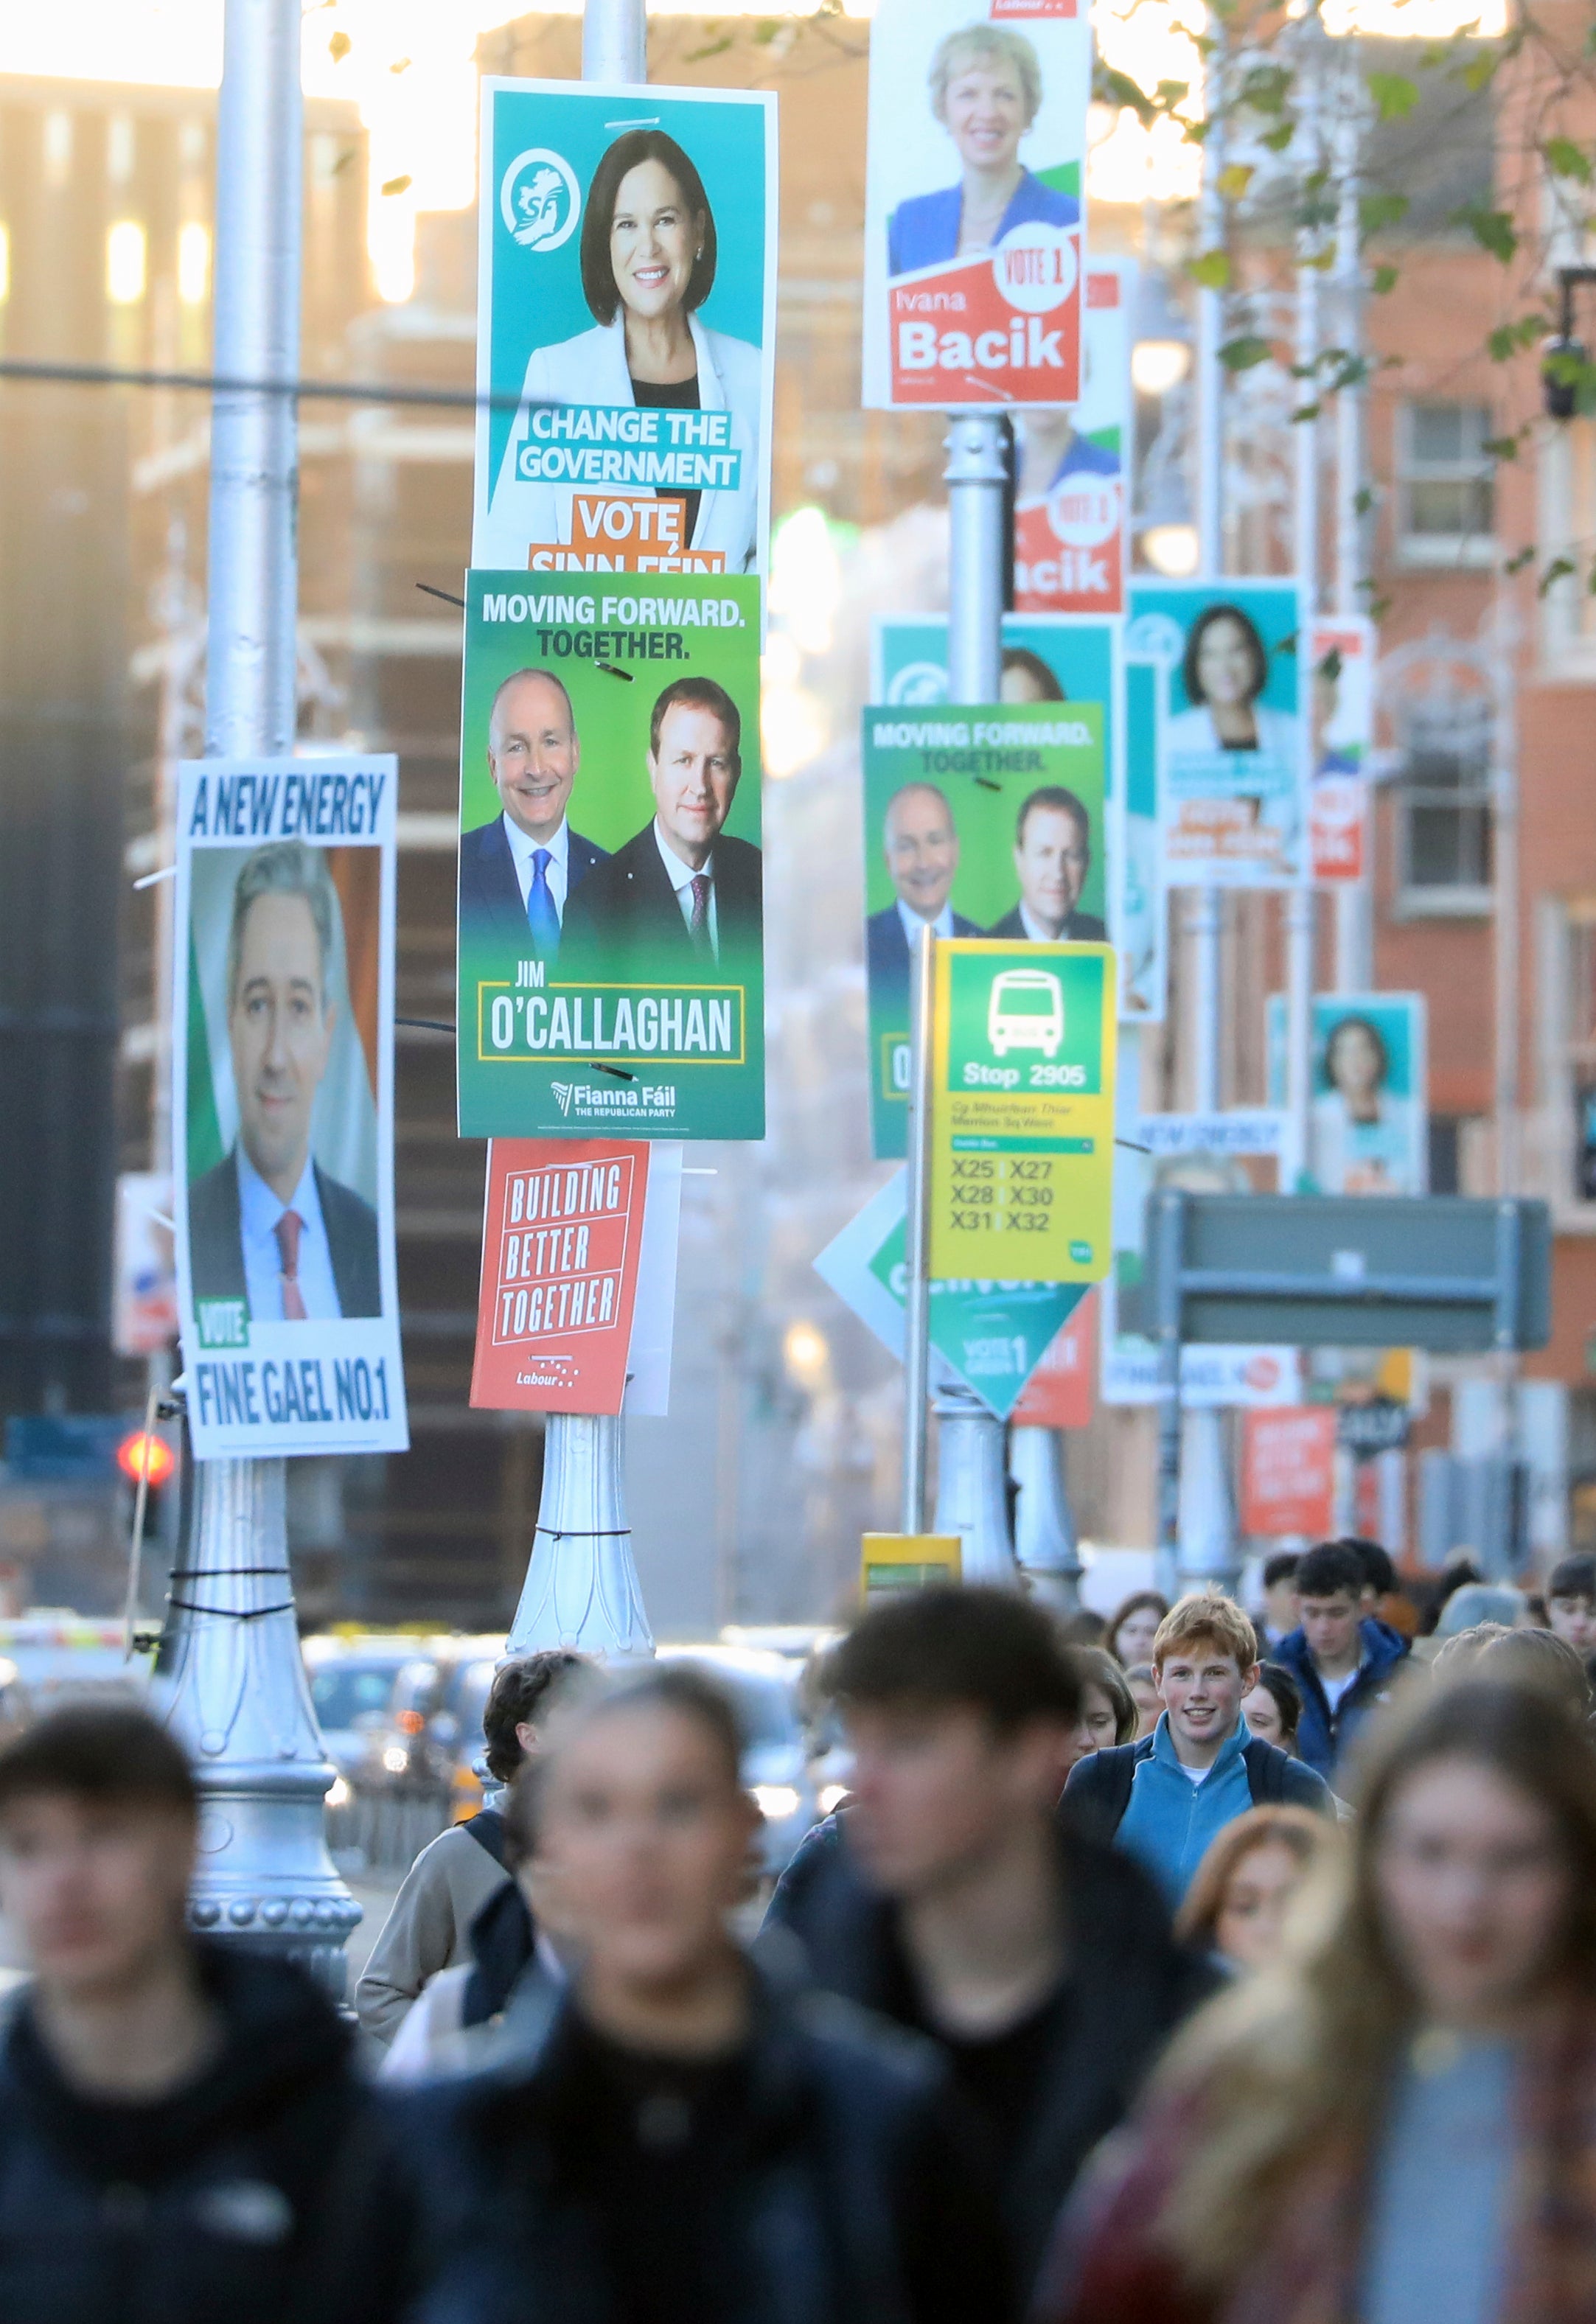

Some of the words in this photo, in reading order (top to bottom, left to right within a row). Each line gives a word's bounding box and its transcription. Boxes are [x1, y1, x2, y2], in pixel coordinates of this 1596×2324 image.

[526, 195, 559, 220] SF
[1005, 248, 1045, 285] VOTE
[1053, 247, 1064, 285] 1
[896, 290, 966, 312] Ivana
[898, 316, 1065, 370] Bacik
[531, 409, 658, 442] CHANGE
[666, 413, 728, 445] THE
[518, 445, 736, 486] GOVERNMENT
[577, 500, 680, 542] VOTE
[483, 594, 596, 625] MOVING
[601, 596, 745, 627] FORWARD.
[536, 629, 690, 660] TOGETHER.
[873, 723, 969, 748] MOVING
[973, 722, 1093, 747] FORWARD.
[921, 750, 1047, 773] TOGETHER.
[189, 775, 209, 836] A
[214, 774, 282, 836] NEW
[279, 772, 386, 836] ENERGY
[515, 960, 544, 988] JIM
[491, 995, 731, 1052] O'CALLAGHAN
[962, 1061, 1020, 1089] Stop
[1029, 1064, 1087, 1087] 2905
[574, 1085, 638, 1106] Fianna
[642, 1086, 676, 1106] Fáil
[575, 1108, 592, 1116] THE
[593, 1108, 647, 1117] REPUBLICAN
[648, 1109, 676, 1117] PARTY
[949, 1159, 994, 1179] X25
[1009, 1160, 1053, 1179] X27
[509, 1164, 621, 1224] BUILDING
[949, 1185, 994, 1204] X28
[1008, 1187, 1054, 1207] X30
[949, 1211, 993, 1231] X31
[1006, 1212, 1050, 1232] X32
[505, 1225, 590, 1280] BETTER
[198, 1300, 246, 1344] VOTE
[501, 1277, 616, 1337] TOGETHER
[195, 1361, 260, 1426] FINE
[262, 1358, 332, 1423] GAEL
[333, 1356, 390, 1421] NO.1
[516, 1371, 558, 1386] Labour
